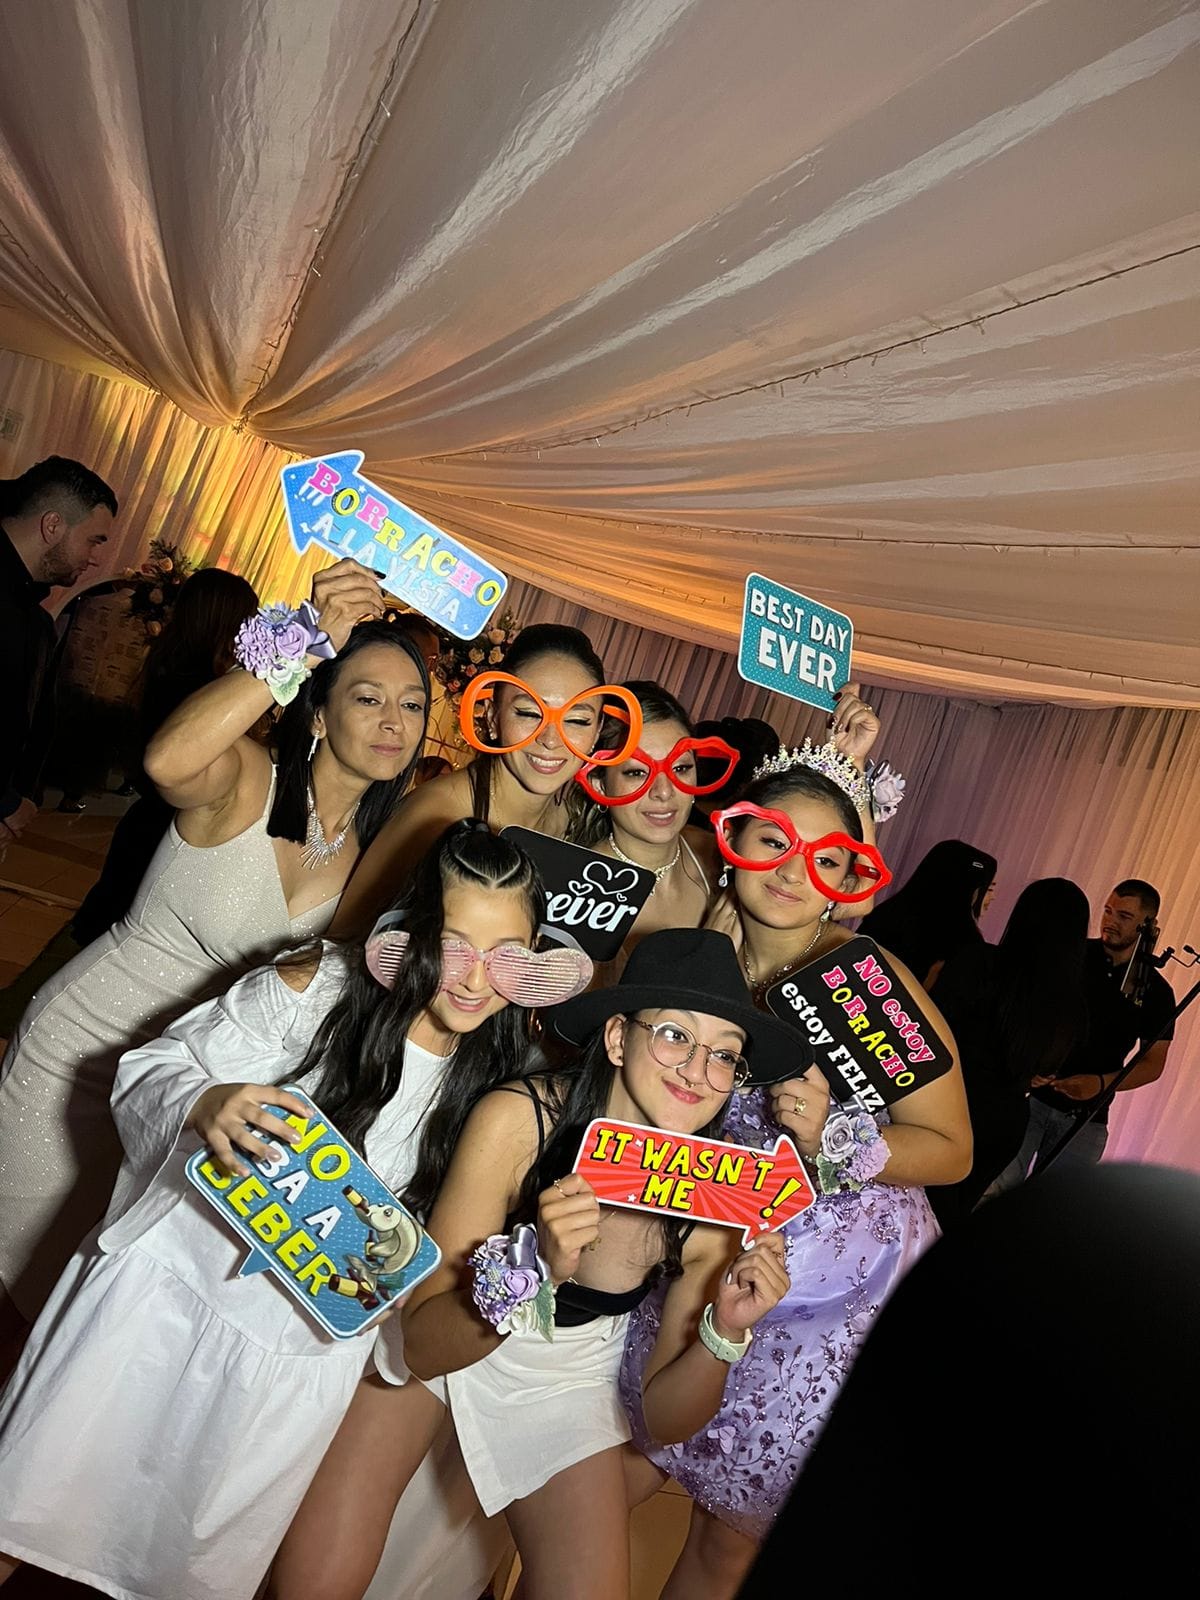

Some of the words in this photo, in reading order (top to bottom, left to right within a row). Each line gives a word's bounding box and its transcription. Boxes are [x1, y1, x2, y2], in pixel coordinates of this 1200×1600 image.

[308, 462, 502, 606] BORRACHO
[311, 513, 335, 541] A
[384, 557, 461, 623] VISTA
[750, 588, 805, 634] BEST
[810, 615, 849, 652] DAY
[758, 626, 836, 692] EVER
[546, 891, 638, 932] ever
[781, 982, 834, 1045] estoy
[827, 1045, 886, 1113] FELIZ
[821, 965, 915, 1087] BORRACHO
[853, 955, 892, 997] NO
[882, 998, 936, 1063] estoy
[250, 1129, 310, 1204] BA
[304, 1205, 342, 1240] A
[285, 1114, 351, 1181] NO
[591, 1129, 633, 1163] IT
[641, 1175, 696, 1210] ME
